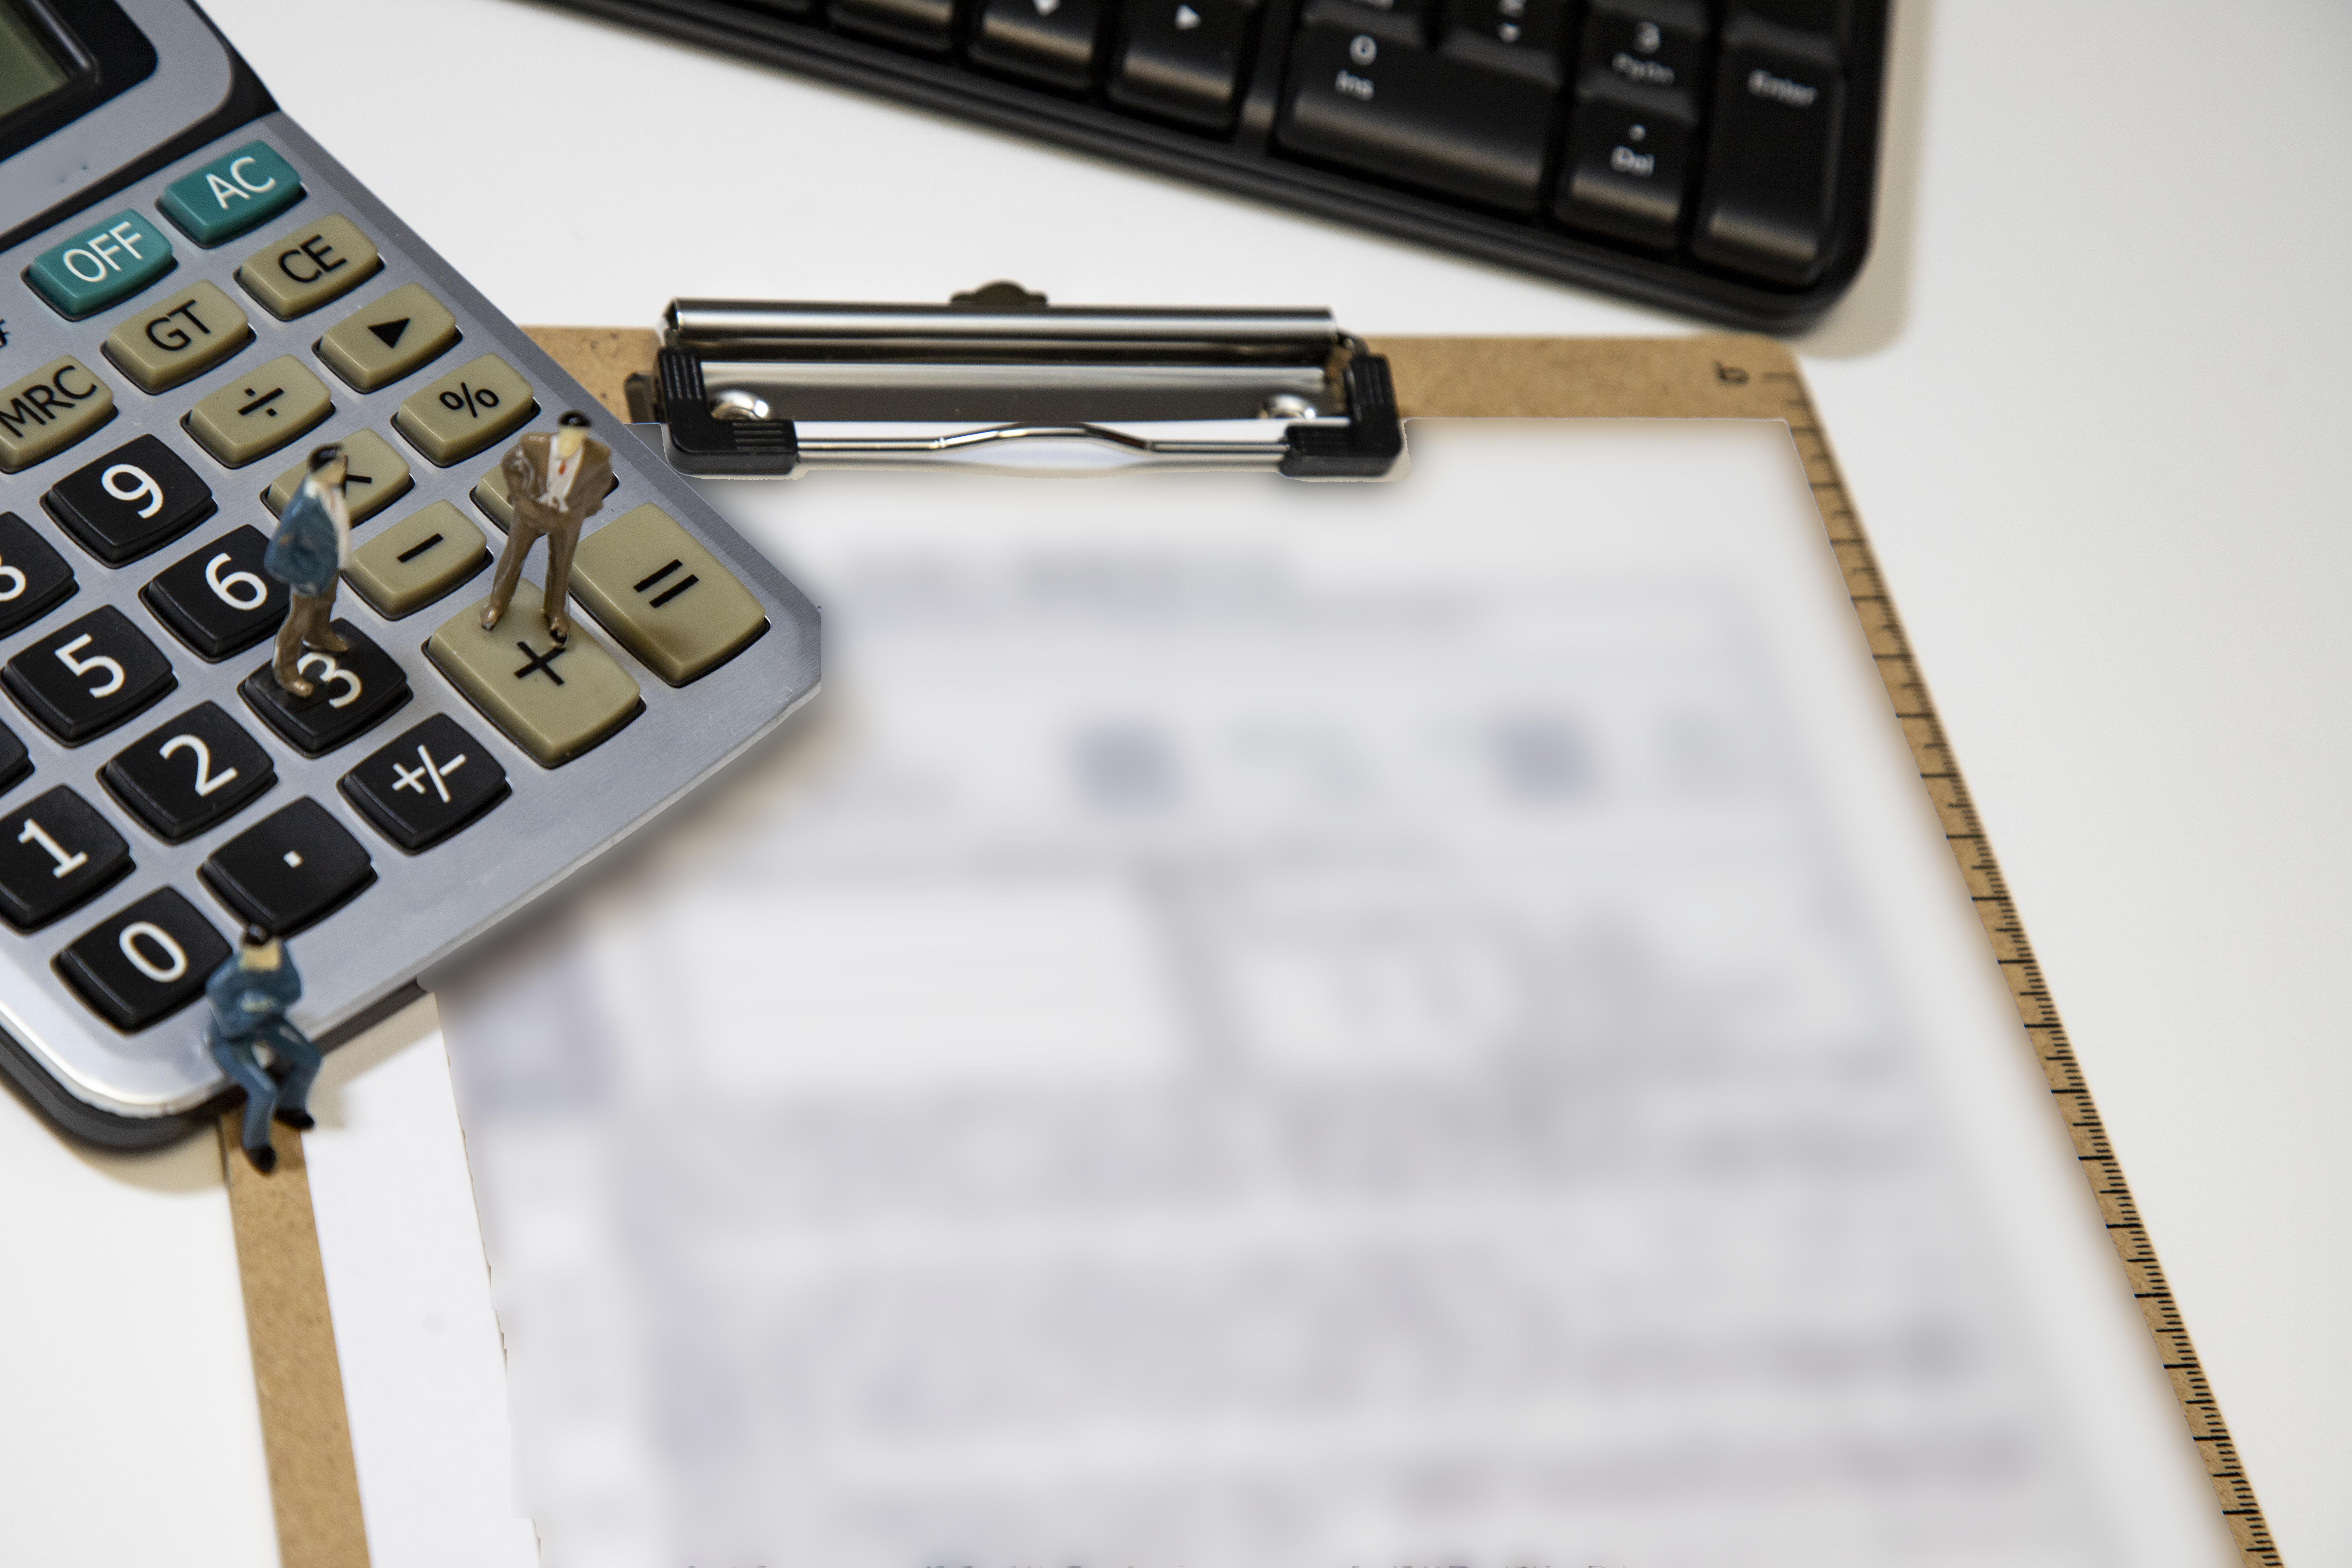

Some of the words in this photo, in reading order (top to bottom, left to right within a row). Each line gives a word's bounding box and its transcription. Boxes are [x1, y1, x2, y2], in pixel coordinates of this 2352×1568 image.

[205, 156, 276, 210] AC
[62, 220, 143, 283] OFF
[278, 234, 347, 283] CE
[144, 299, 211, 351] GT
[0, 364, 97, 438] MRC
[439, 382, 500, 418] %
[101, 463, 163, 519] 9
[205, 553, 268, 611] 6
[54, 633, 125, 698] 5
[297, 652, 361, 708] 3
[159, 734, 238, 797] 2
[18, 819, 88, 878] 1
[119, 922, 188, 983] 0
